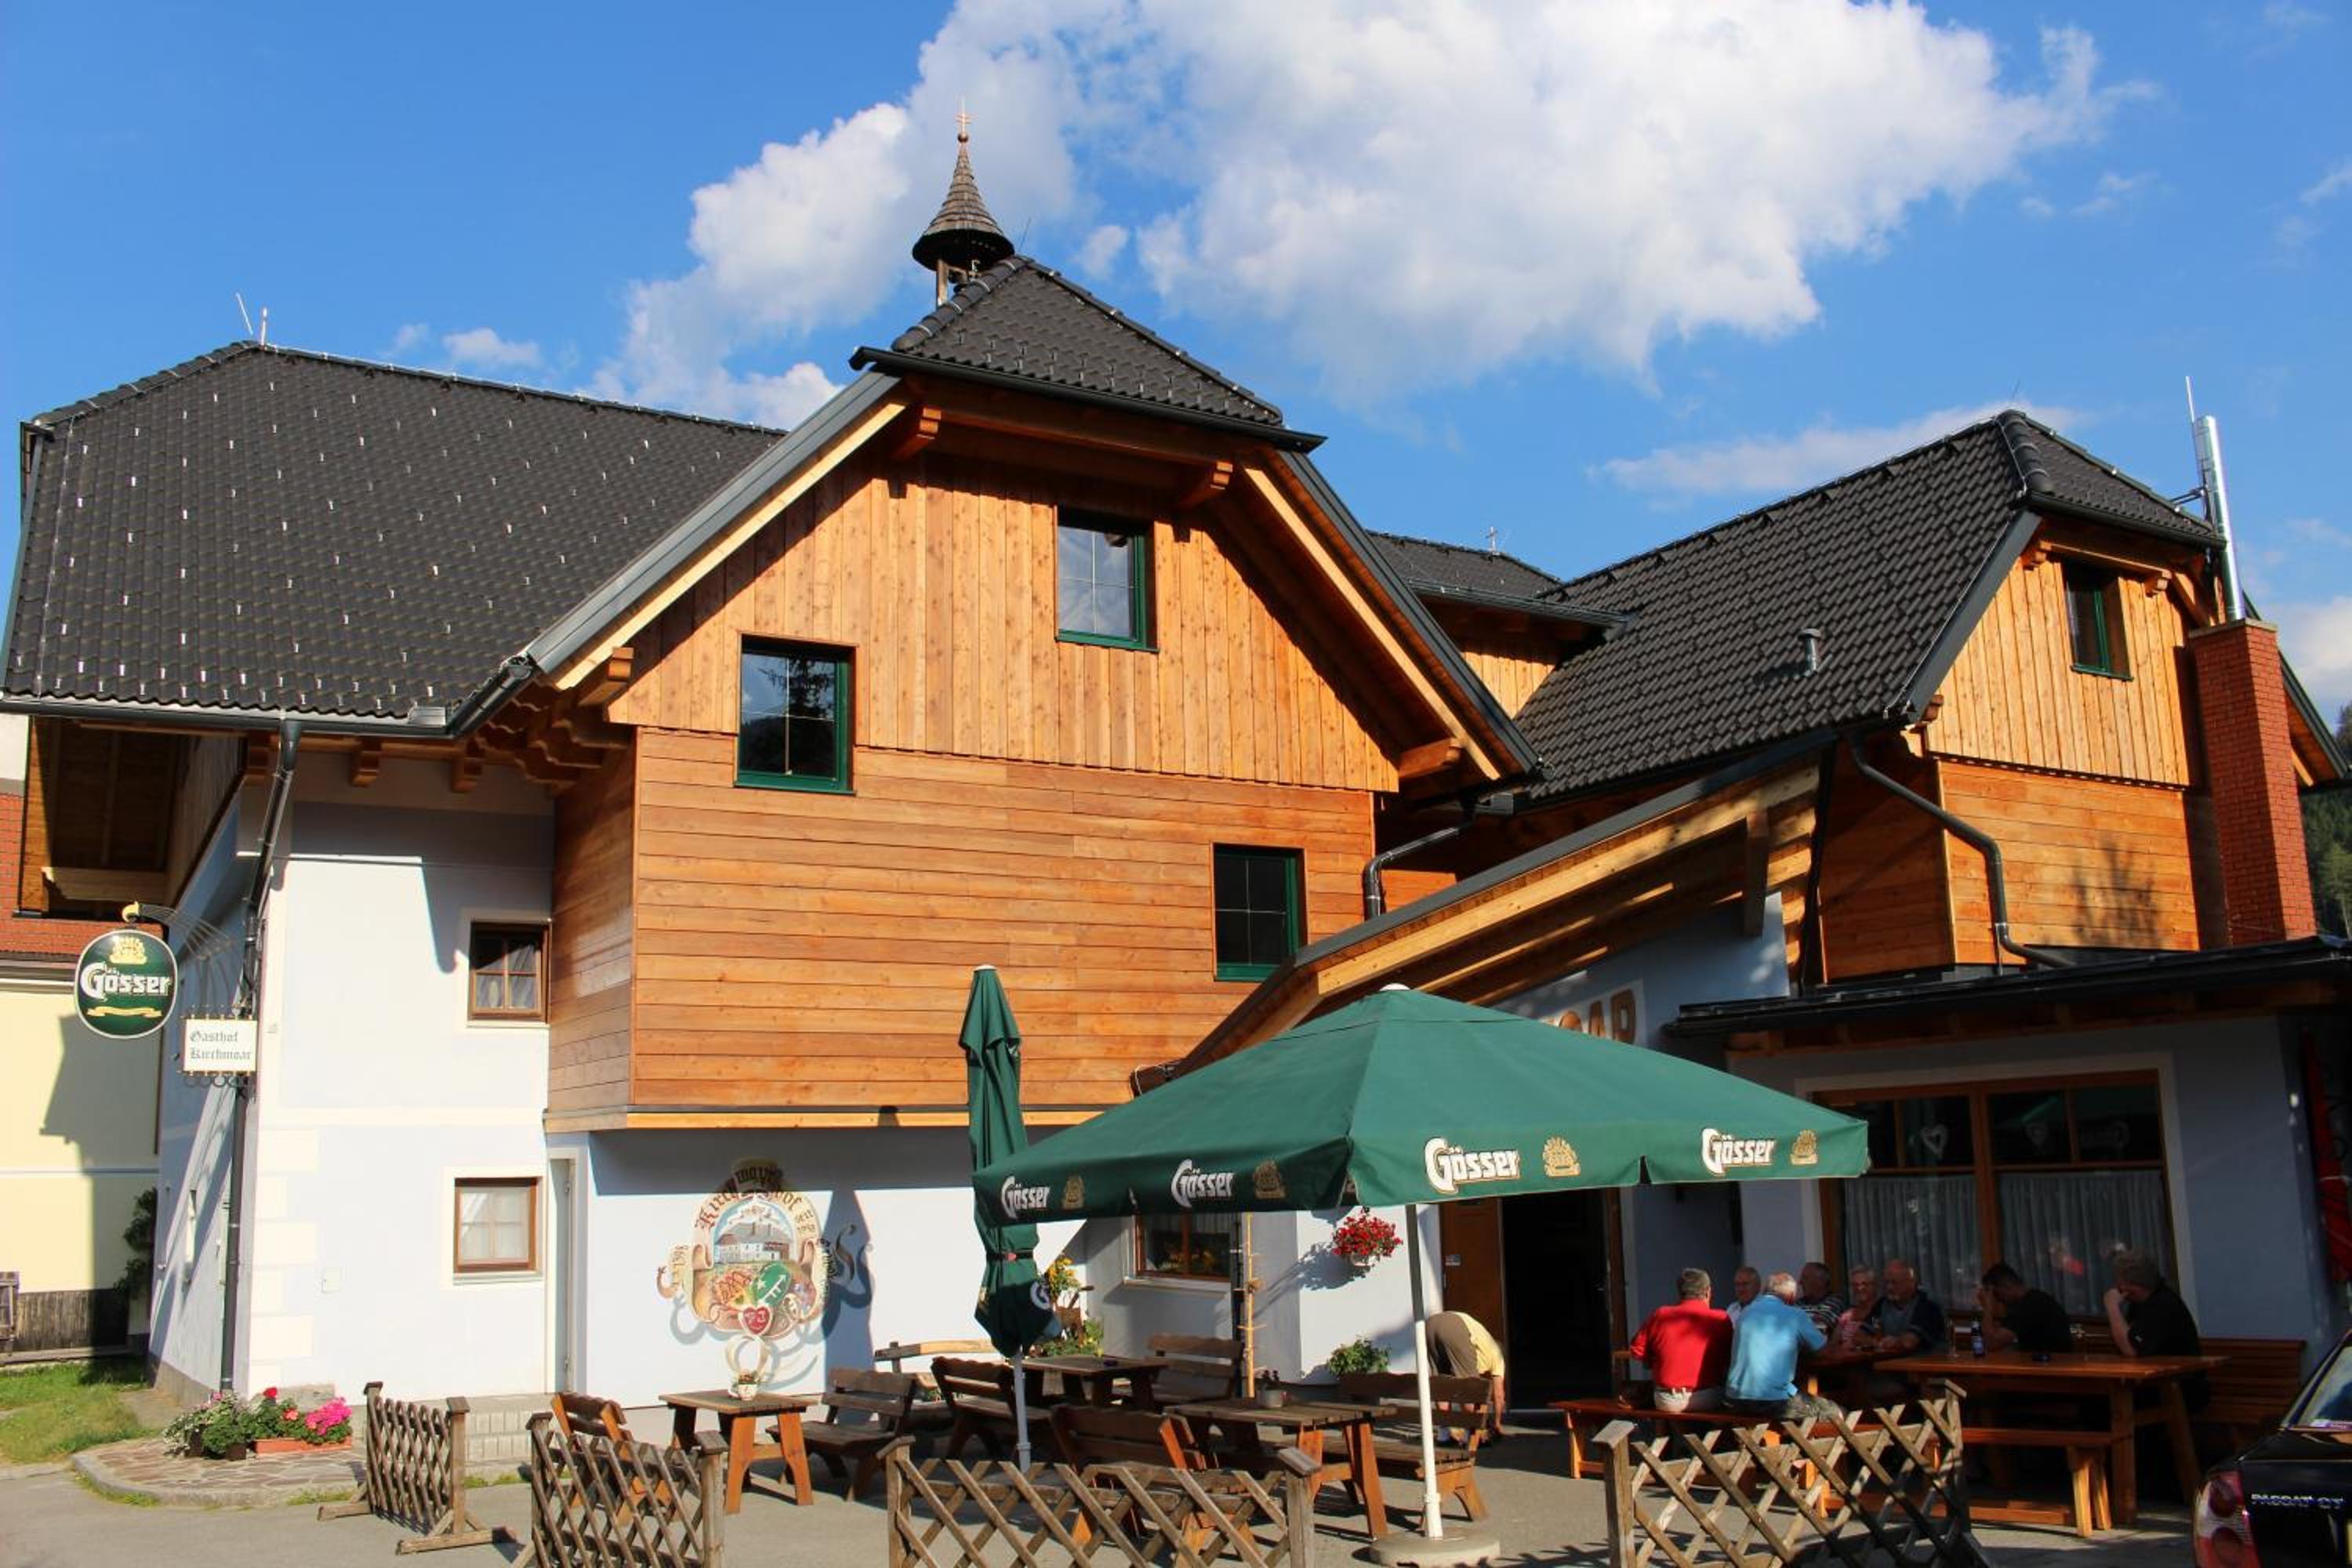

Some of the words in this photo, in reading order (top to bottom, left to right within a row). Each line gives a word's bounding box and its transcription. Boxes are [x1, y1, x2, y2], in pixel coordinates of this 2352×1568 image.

[80, 962, 170, 1002] Gösser
[190, 1029, 239, 1044] Gasthof
[1425, 1137, 1521, 1194] Gösser
[1701, 1128, 1776, 1174] Gösser
[1001, 1176, 1051, 1220] Gösser
[1171, 1159, 1235, 1208] Gösser
